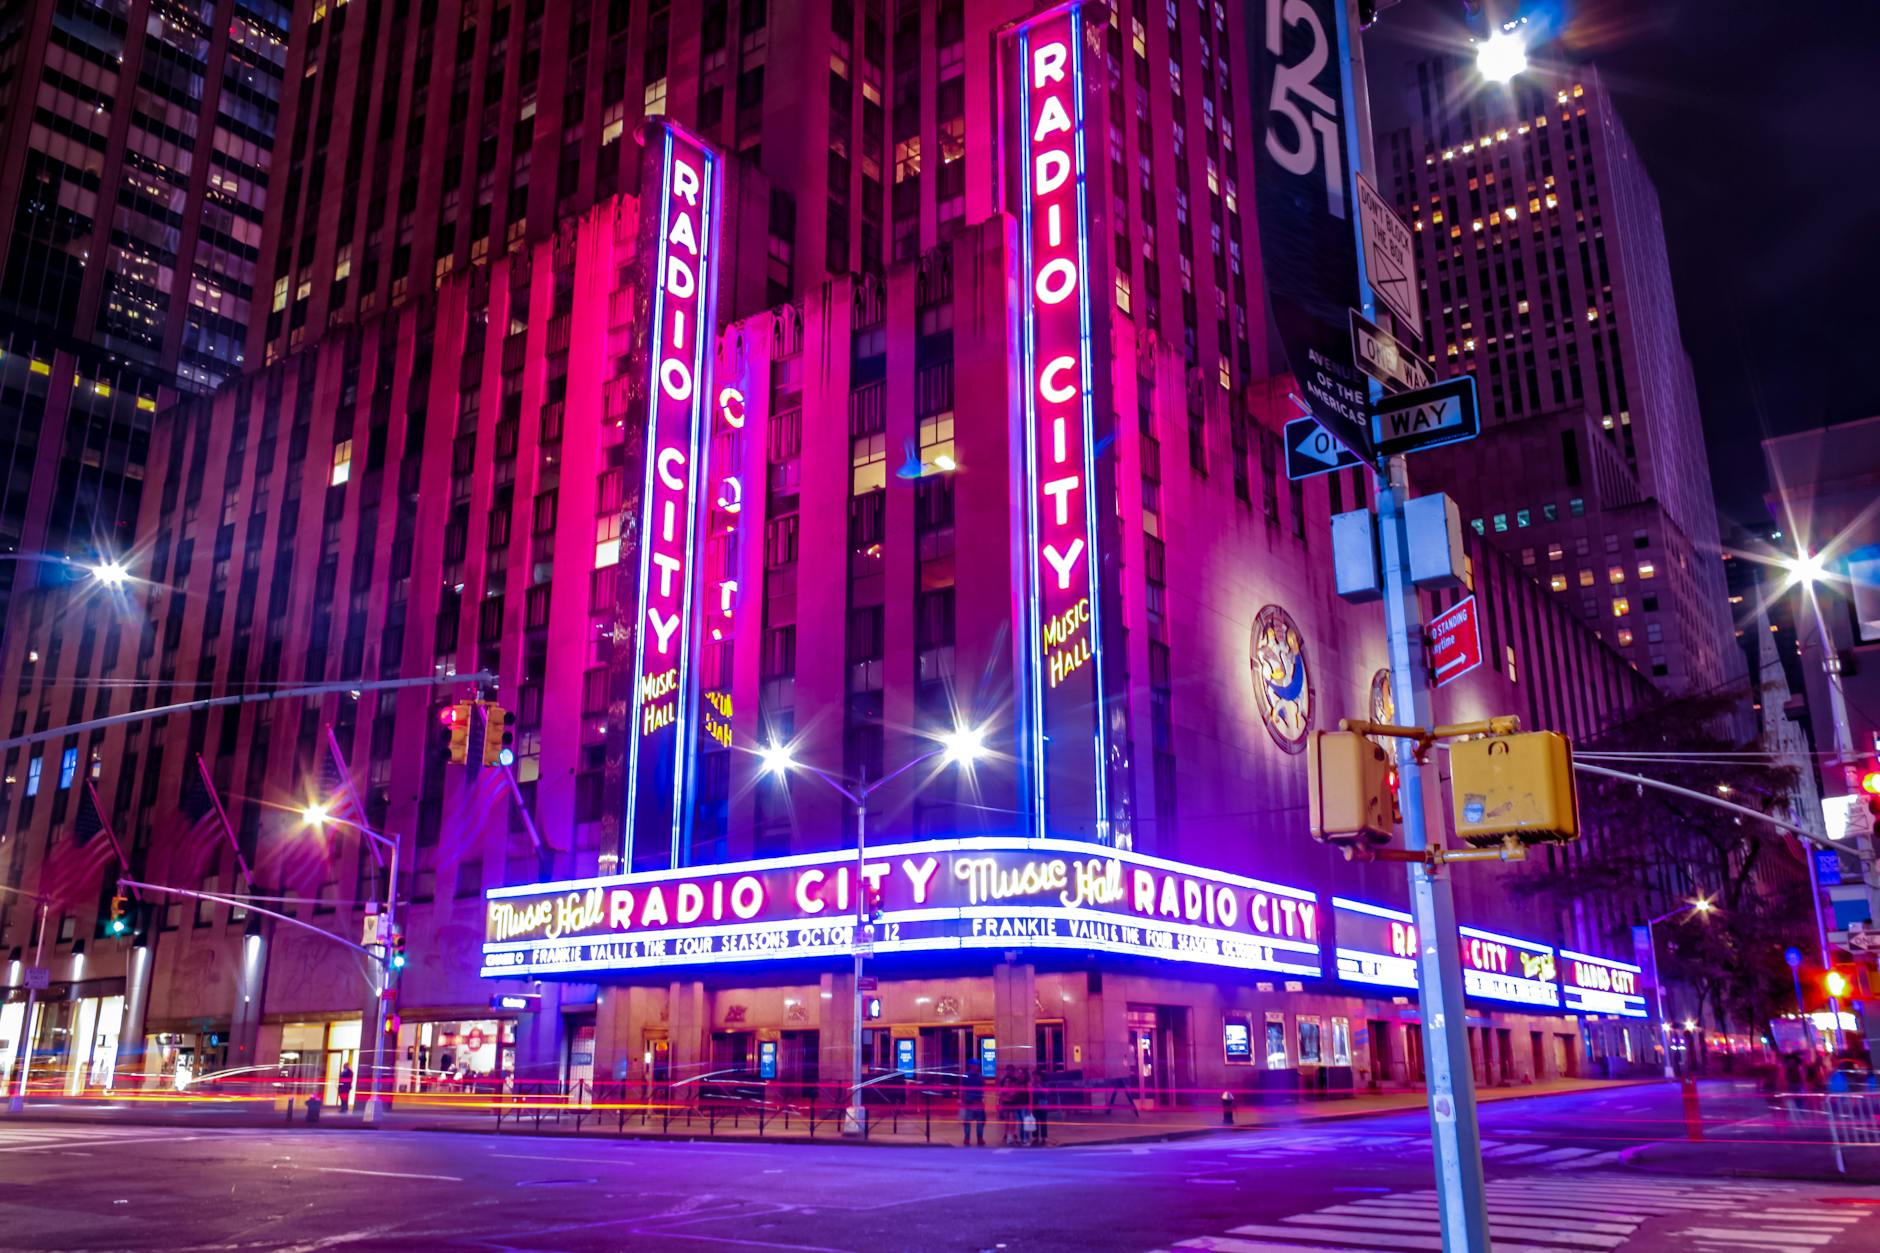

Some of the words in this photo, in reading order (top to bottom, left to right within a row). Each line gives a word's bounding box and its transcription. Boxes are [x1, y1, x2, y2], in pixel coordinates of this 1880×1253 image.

[1033, 41, 1077, 305] RADIO
[659, 158, 700, 401] RADIO
[1308, 348, 1361, 384] AVENUE
[1366, 338, 1396, 373] ONE
[1306, 381, 1367, 427] AMERICAS
[1316, 371, 1334, 389] OF
[1338, 383, 1365, 406] THE
[1389, 402, 1448, 435] WAY
[1039, 355, 1085, 590] CITY
[647, 446, 687, 655] CITY
[1043, 598, 1090, 656] MUSIC
[1437, 609, 1468, 637] STANDING
[1050, 637, 1091, 688] HALL
[641, 667, 680, 705] MUSIC
[643, 702, 675, 737] HALL
[488, 898, 553, 942] Music
[545, 887, 605, 939] Hall
[609, 875, 765, 931] RADIO
[795, 856, 941, 915] CITY
[954, 857, 1068, 905] Music
[1060, 857, 1125, 909] Hall
[1132, 868, 1238, 928] RADIO
[1250, 895, 1316, 940] CITY
[532, 946, 582, 967] FRANKIE
[590, 943, 626, 963] VALLI
[643, 939, 666, 959] THE
[675, 936, 713, 956] FOUR
[721, 930, 790, 952] SEASONS
[884, 923, 900, 941] 12
[971, 917, 1058, 938] FRANKIE
[1068, 919, 1109, 941] VALLI
[1121, 923, 1141, 945] THE
[1145, 929, 1174, 950] FOUR
[1470, 938, 1508, 974] CITY
